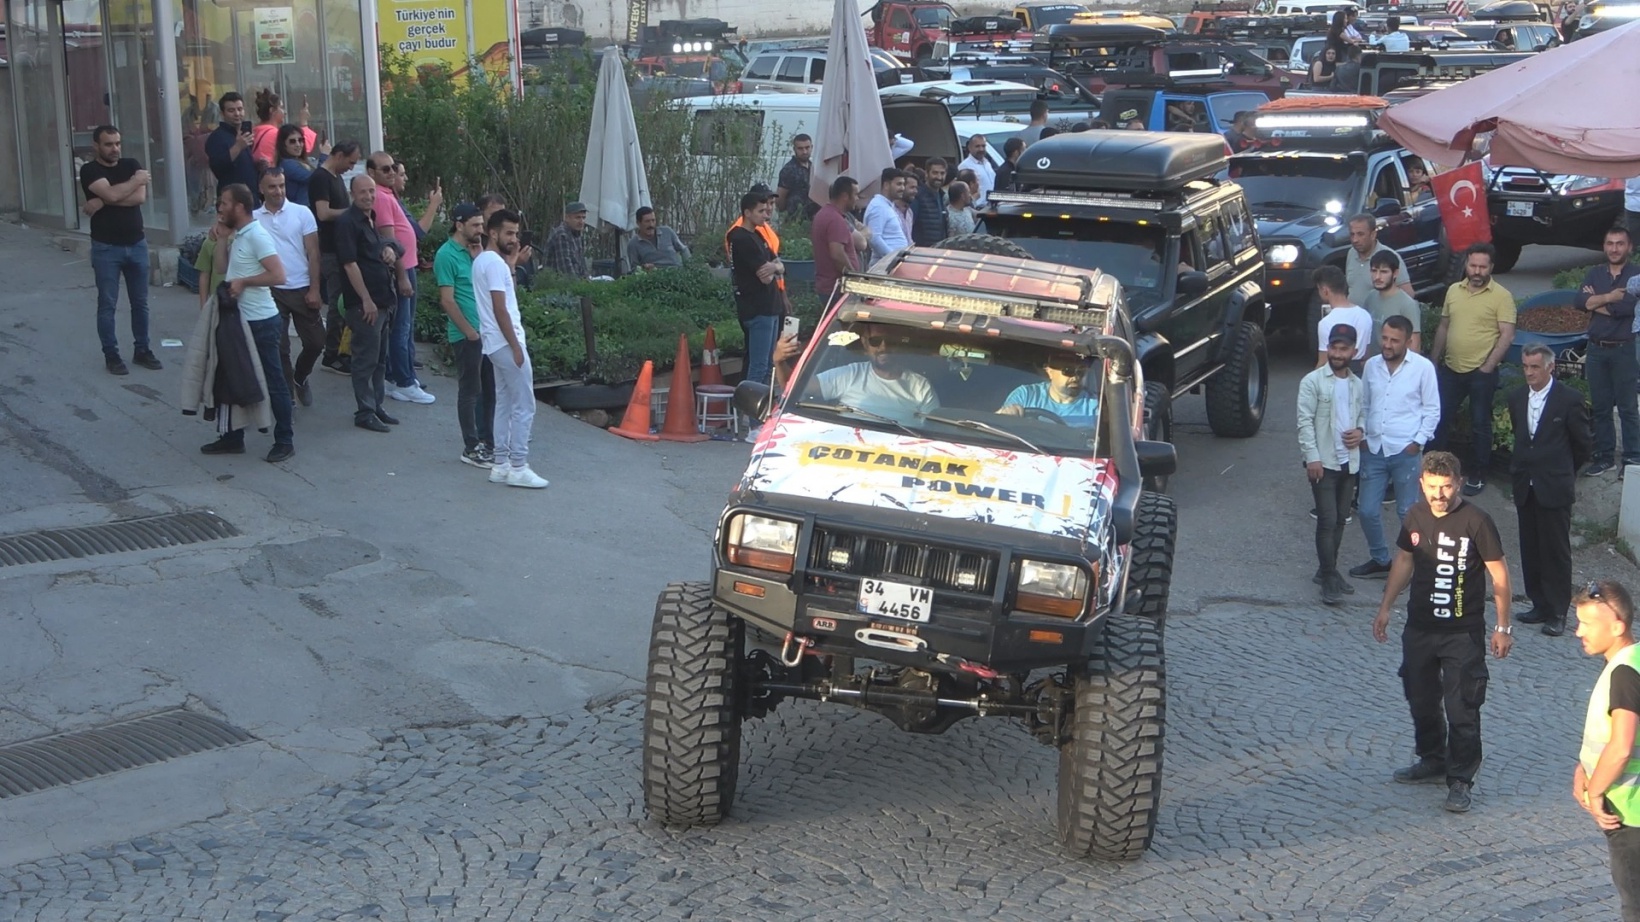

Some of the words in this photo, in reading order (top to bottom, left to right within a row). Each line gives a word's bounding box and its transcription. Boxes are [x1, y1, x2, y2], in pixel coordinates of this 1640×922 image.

[395, 8, 455, 22] Türkiye'nin
[407, 23, 446, 37] gerçek
[399, 40, 421, 52] çayı
[425, 37, 457, 49] budur
[901, 475, 1046, 510] POWER
[1457, 558, 1467, 571] Off
[1430, 531, 1456, 618] GÜMOFF
[864, 580, 885, 596] 34
[910, 587, 930, 604] VM
[879, 601, 921, 620] 4456
[816, 620, 834, 629] ARB
